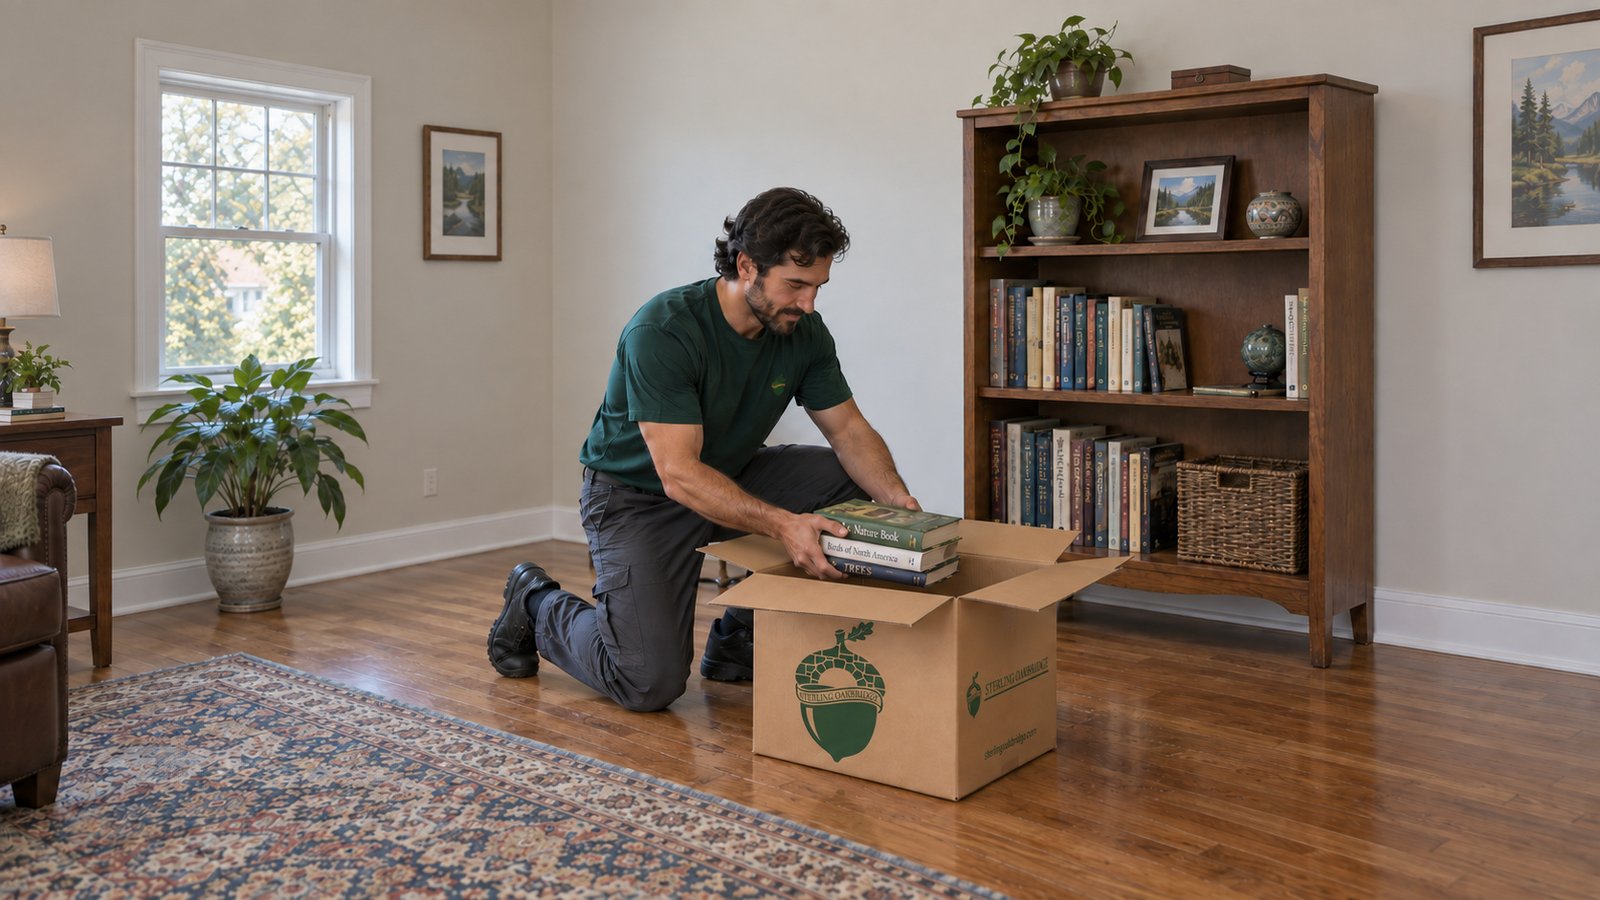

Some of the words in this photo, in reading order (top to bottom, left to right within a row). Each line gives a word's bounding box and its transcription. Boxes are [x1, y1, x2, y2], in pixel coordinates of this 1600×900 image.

[854, 524, 879, 539] Nature
[880, 529, 900, 543] Book
[827, 541, 844, 553] Birds
[844, 544, 852, 554] of
[853, 546, 871, 559] North
[872, 551, 899, 564] America
[843, 562, 873, 576] TREES
[985, 672, 1015, 696] STERLING
